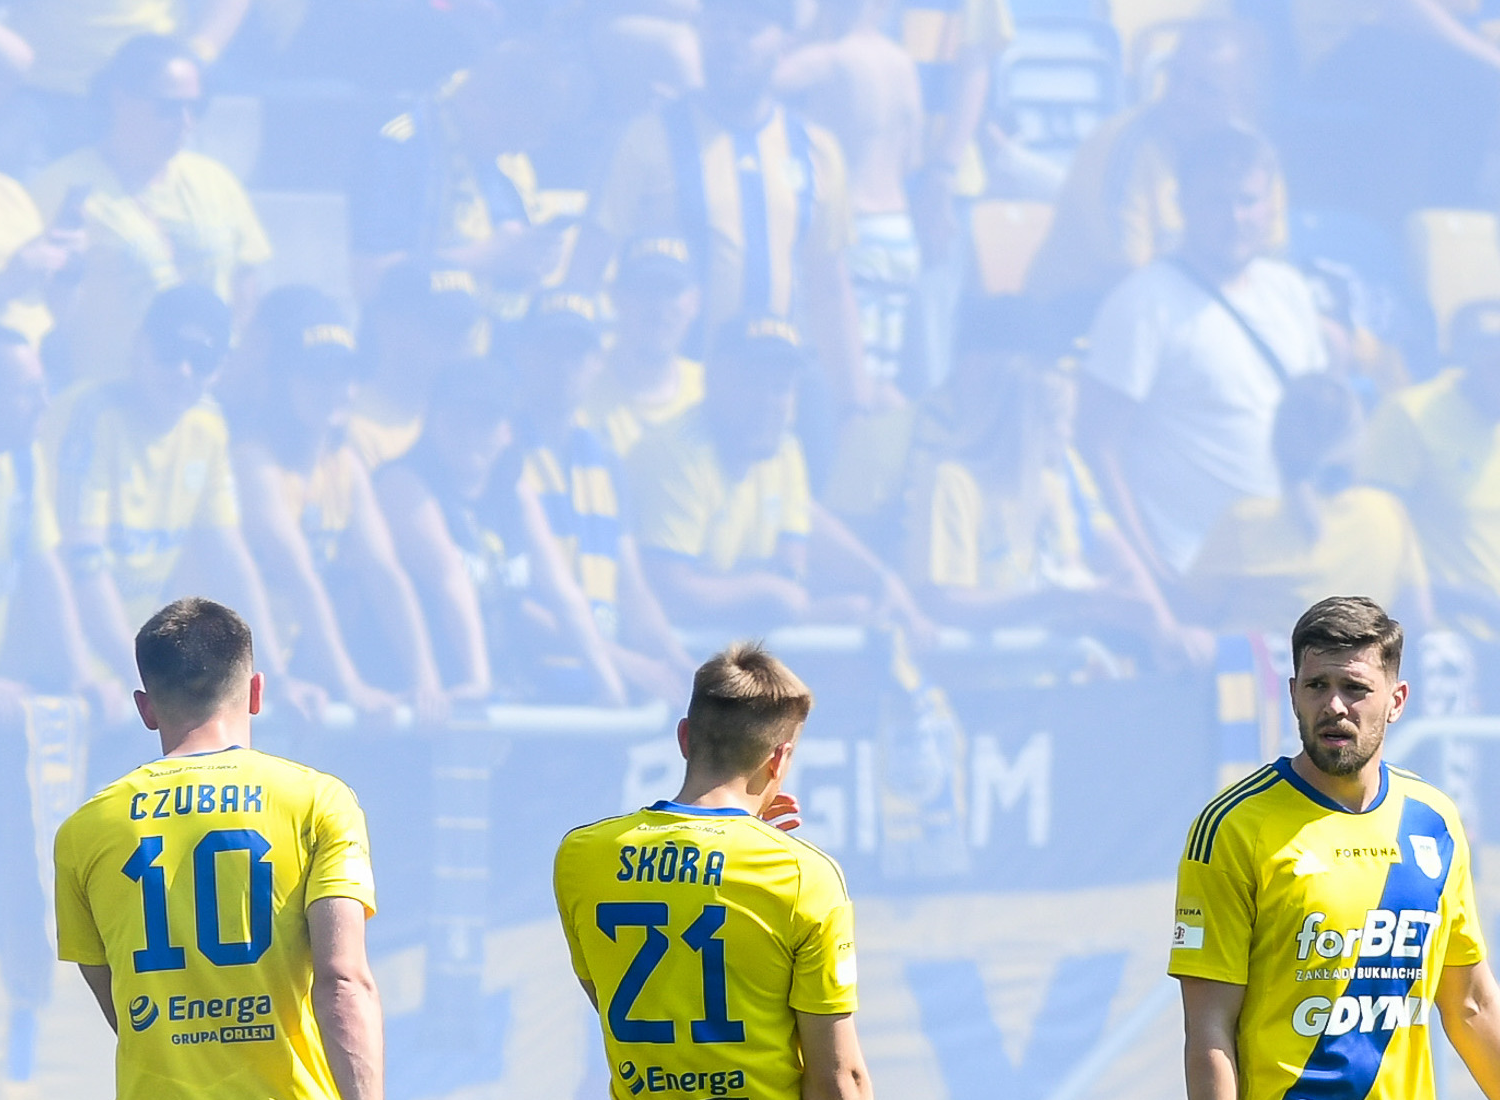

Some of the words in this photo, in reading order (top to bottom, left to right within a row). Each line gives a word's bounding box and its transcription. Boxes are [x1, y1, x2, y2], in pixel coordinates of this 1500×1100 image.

[130, 784, 262, 820] CZUBAK
[1336, 847, 1398, 858] FORTUNA
[121, 829, 272, 973] 10
[1175, 908, 1202, 916] TUNA
[1296, 909, 1442, 960] forBET
[596, 902, 746, 1044] 21
[1357, 967, 1427, 980] BUKMACHE
[169, 995, 272, 1023] Energa
[171, 1031, 219, 1045] GRUPA
[222, 1027, 272, 1041] ORLEN
[647, 1066, 745, 1096] Energa
